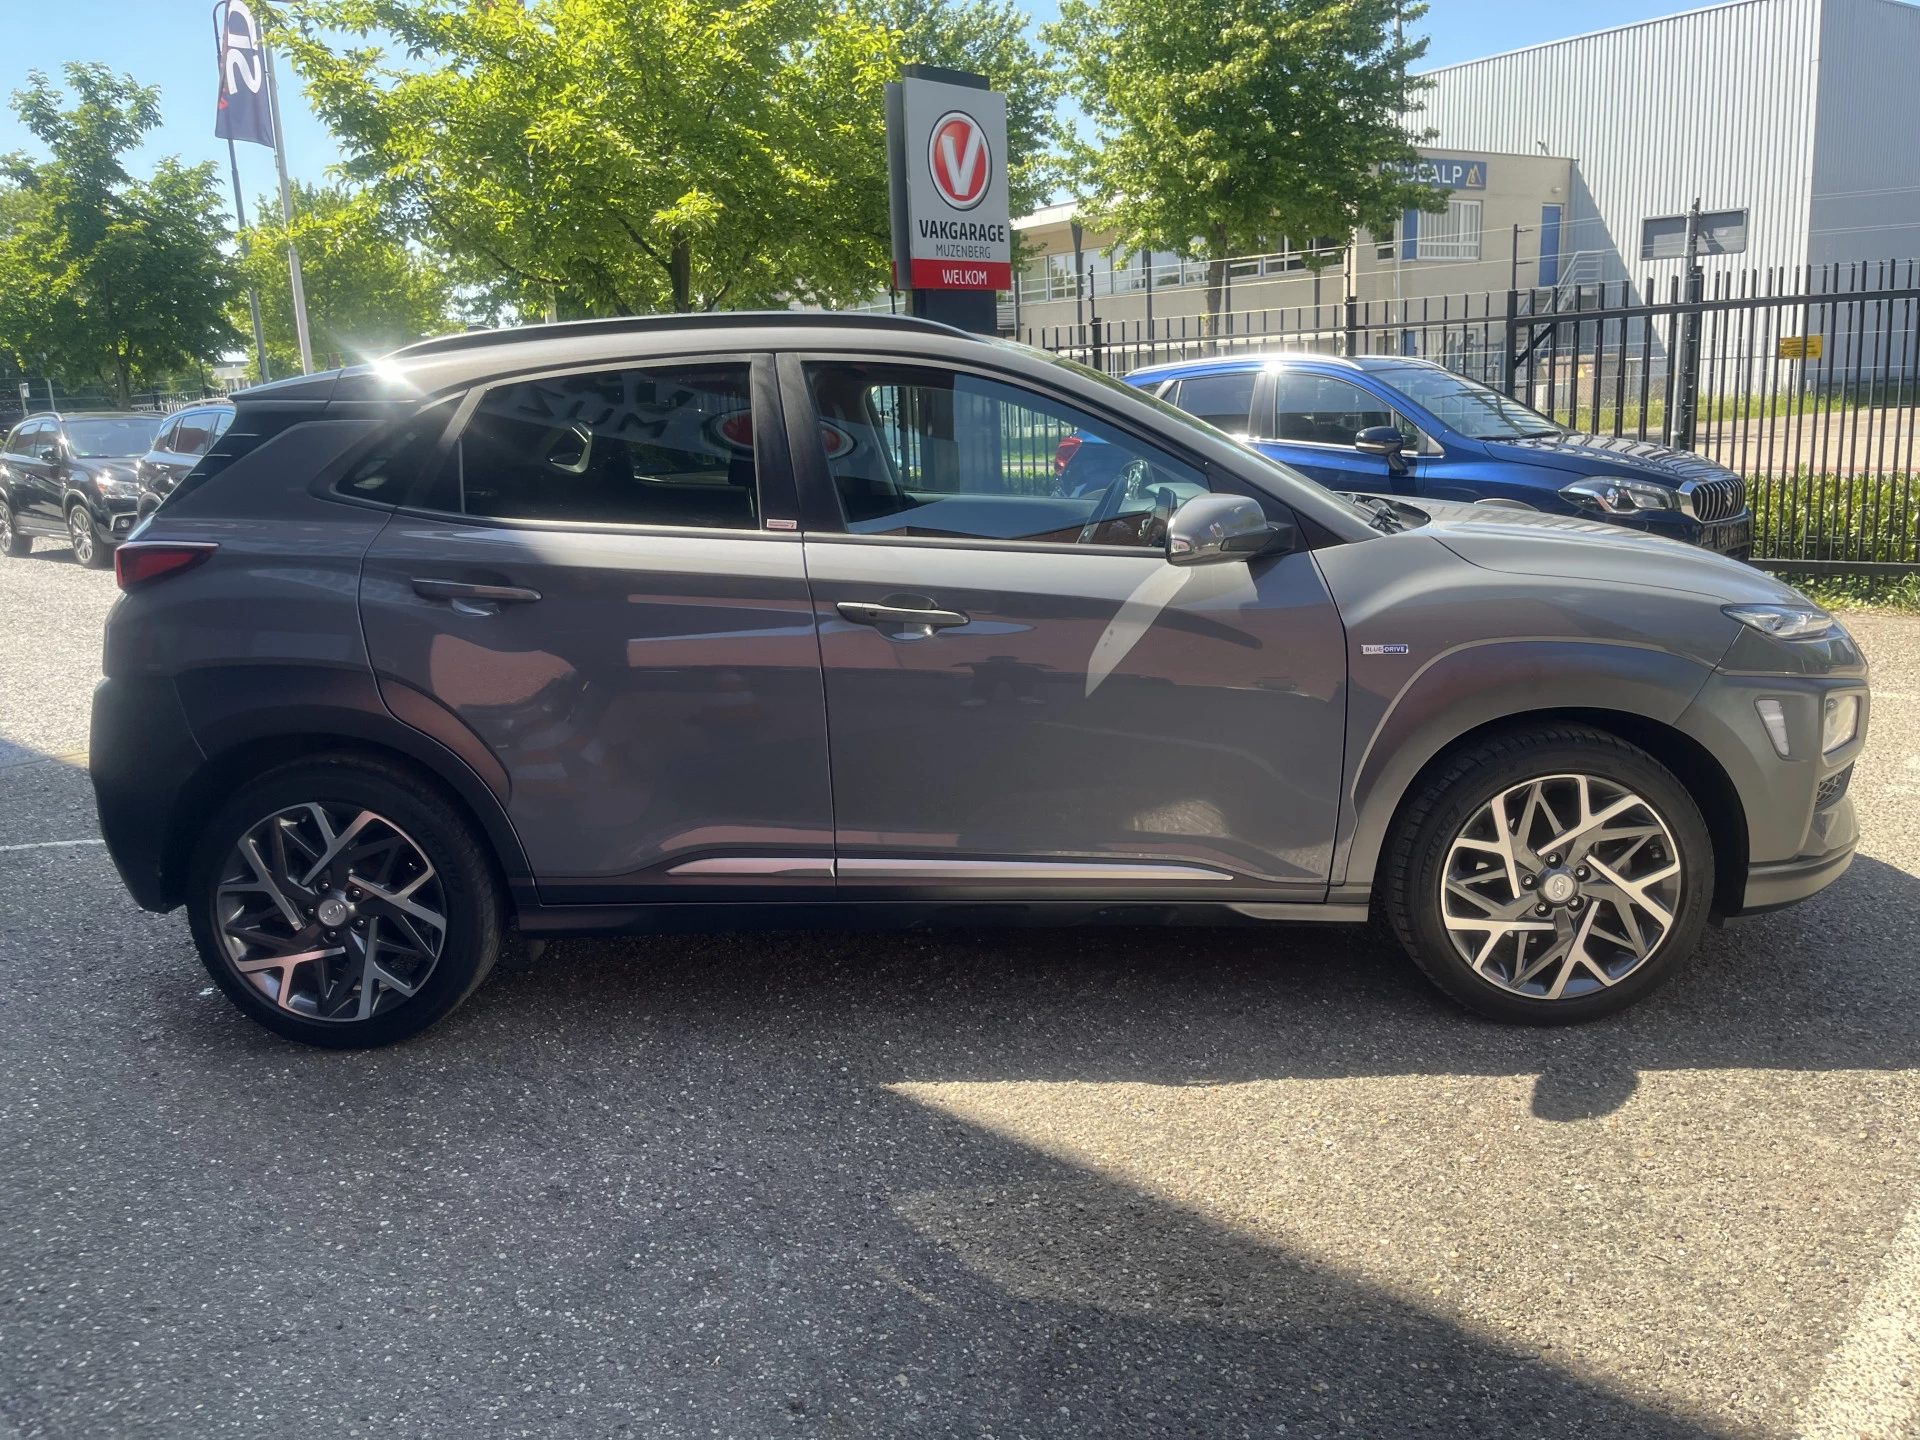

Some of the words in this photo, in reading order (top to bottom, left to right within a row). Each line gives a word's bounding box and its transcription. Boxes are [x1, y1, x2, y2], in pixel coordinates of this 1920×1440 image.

[919, 219, 1005, 243] VAKGARAGE
[936, 244, 991, 259] MUZENBERG
[942, 269, 988, 285] WELKOM
